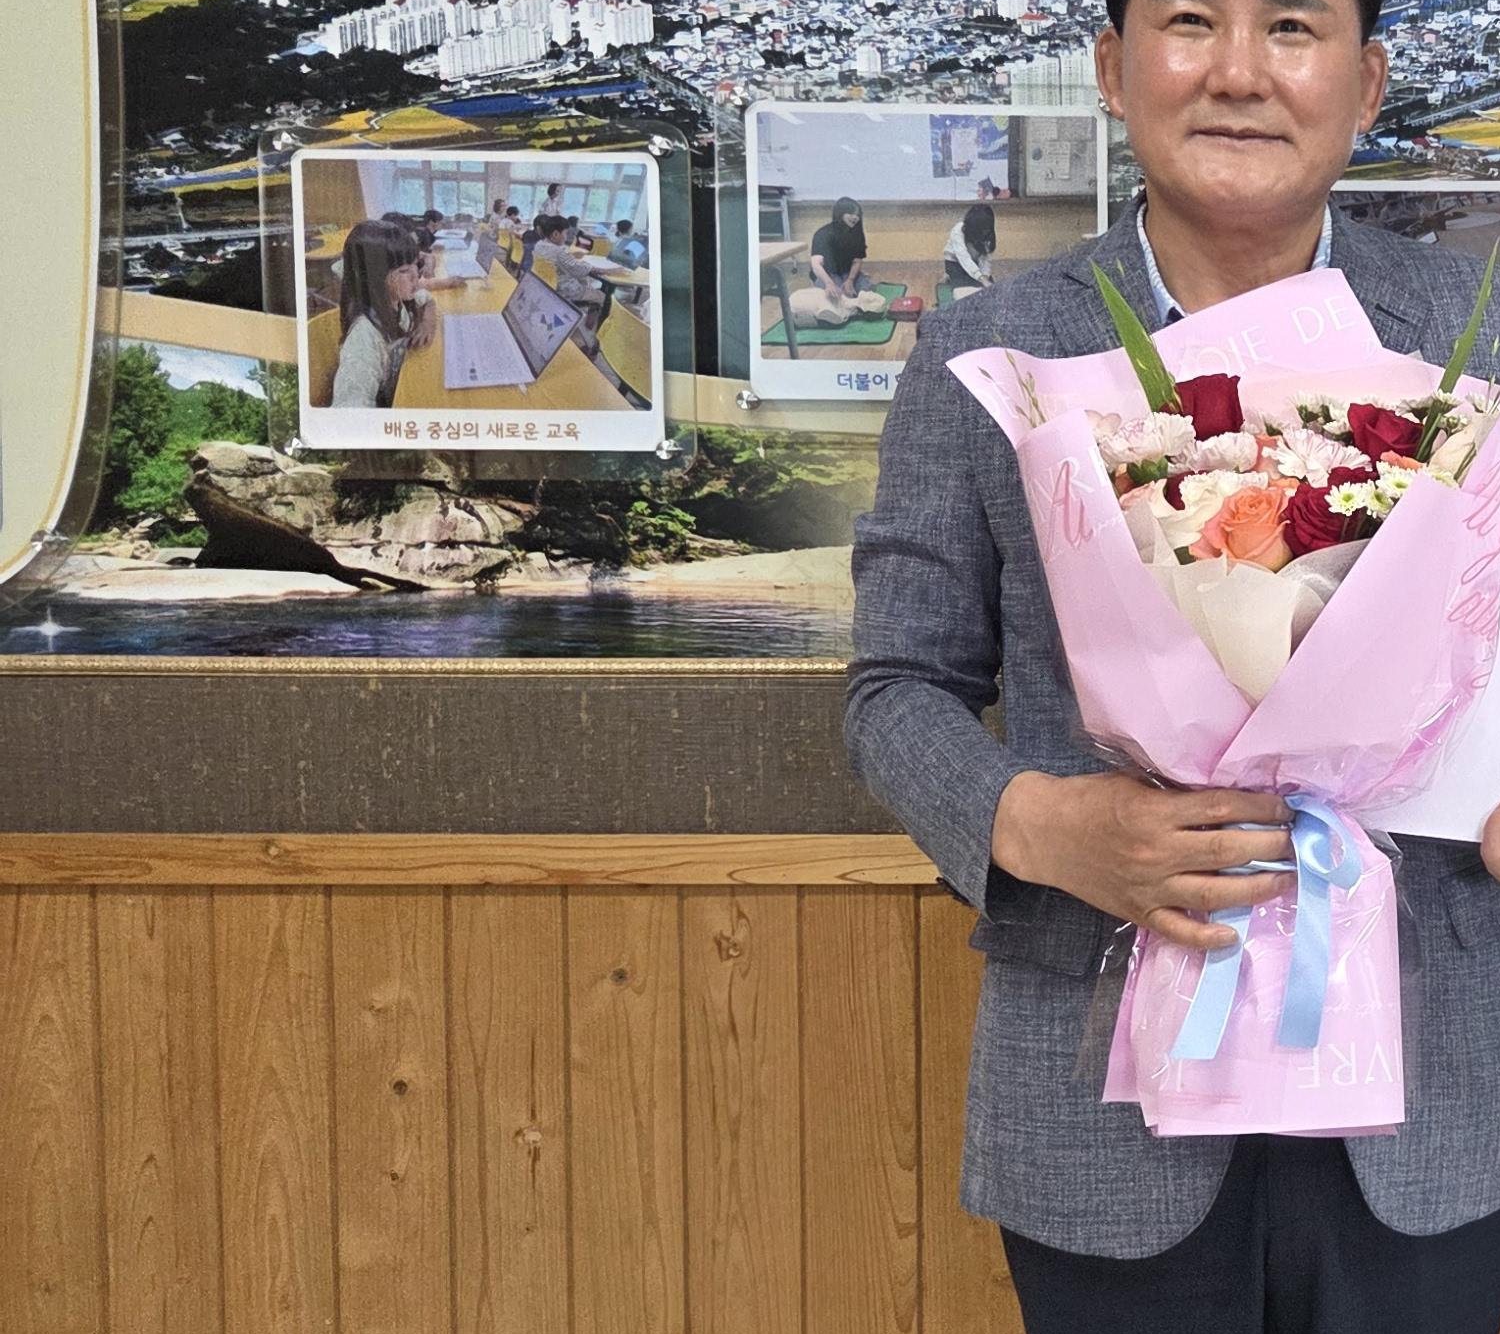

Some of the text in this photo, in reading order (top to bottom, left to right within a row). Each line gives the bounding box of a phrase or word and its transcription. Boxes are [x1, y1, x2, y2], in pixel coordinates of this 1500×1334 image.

[1290, 295, 1357, 346] DE
[837, 372, 889, 392] 더불어
[383, 422, 582, 442] 배움 중심의 새로운 교육
